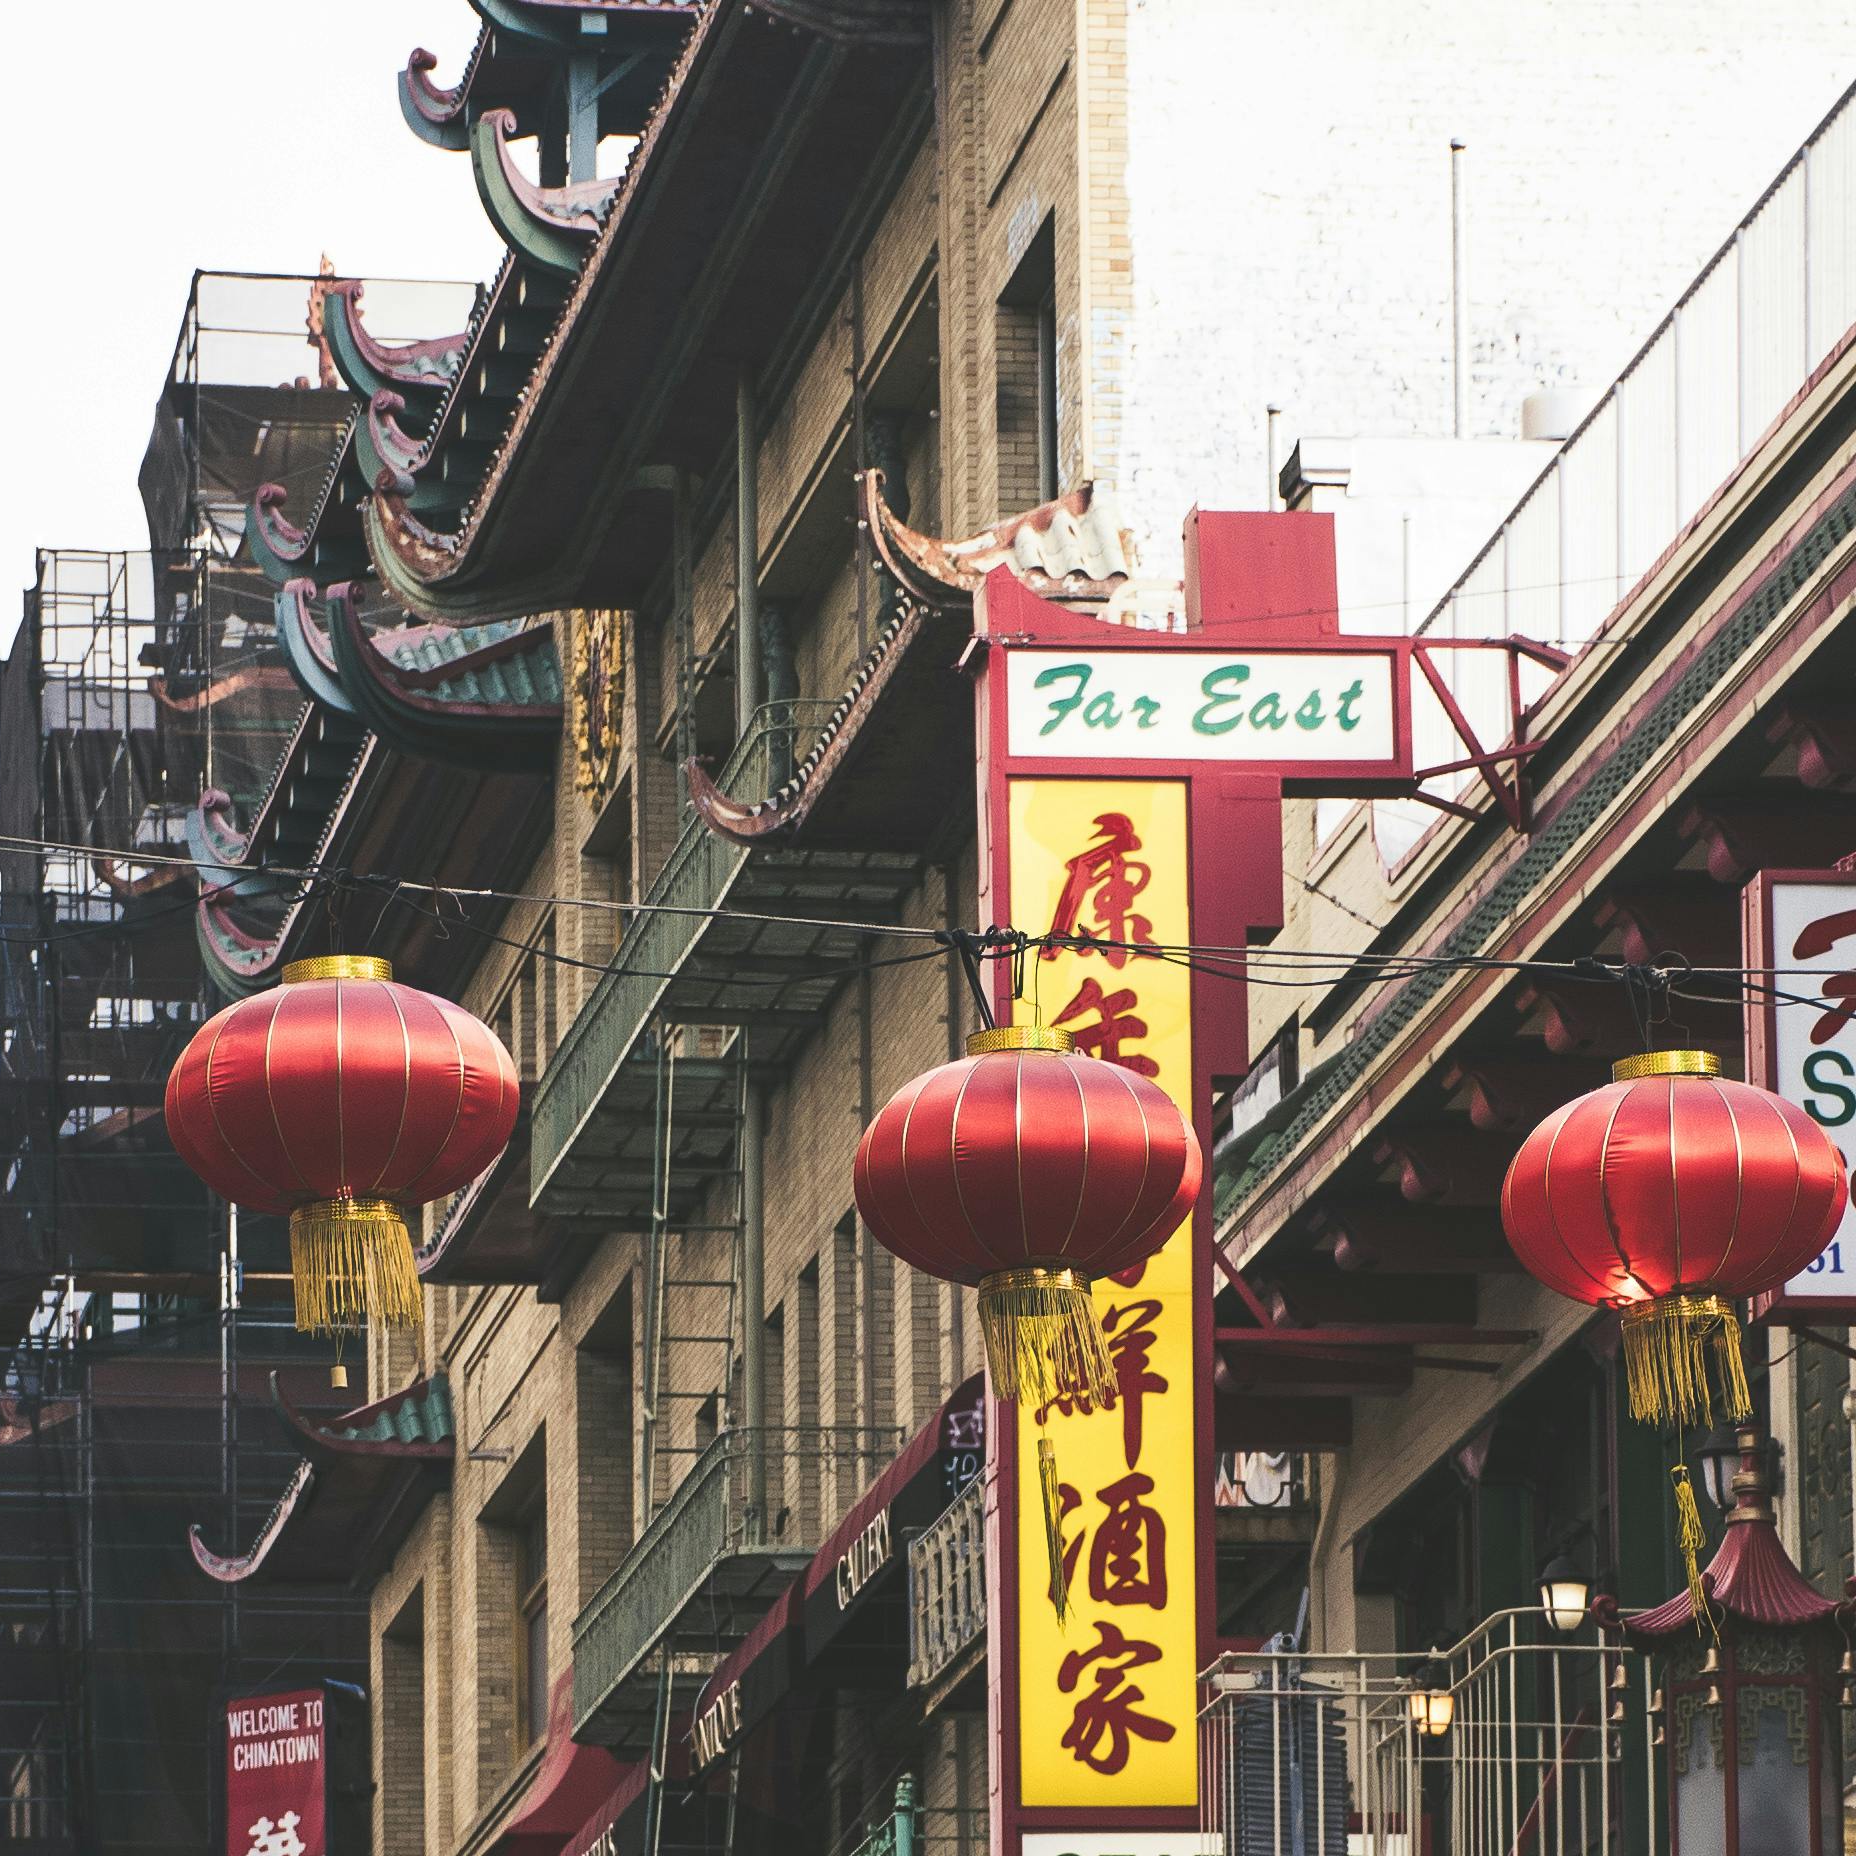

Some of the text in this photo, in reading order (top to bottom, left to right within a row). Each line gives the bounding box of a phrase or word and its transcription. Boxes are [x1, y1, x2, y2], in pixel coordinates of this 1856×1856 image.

[1034, 663, 1365, 737] Far East
[836, 1502, 894, 1612] GALLERY
[227, 1699, 323, 1739] WELCOME TO
[233, 1734, 320, 1772] CHINATOWN
